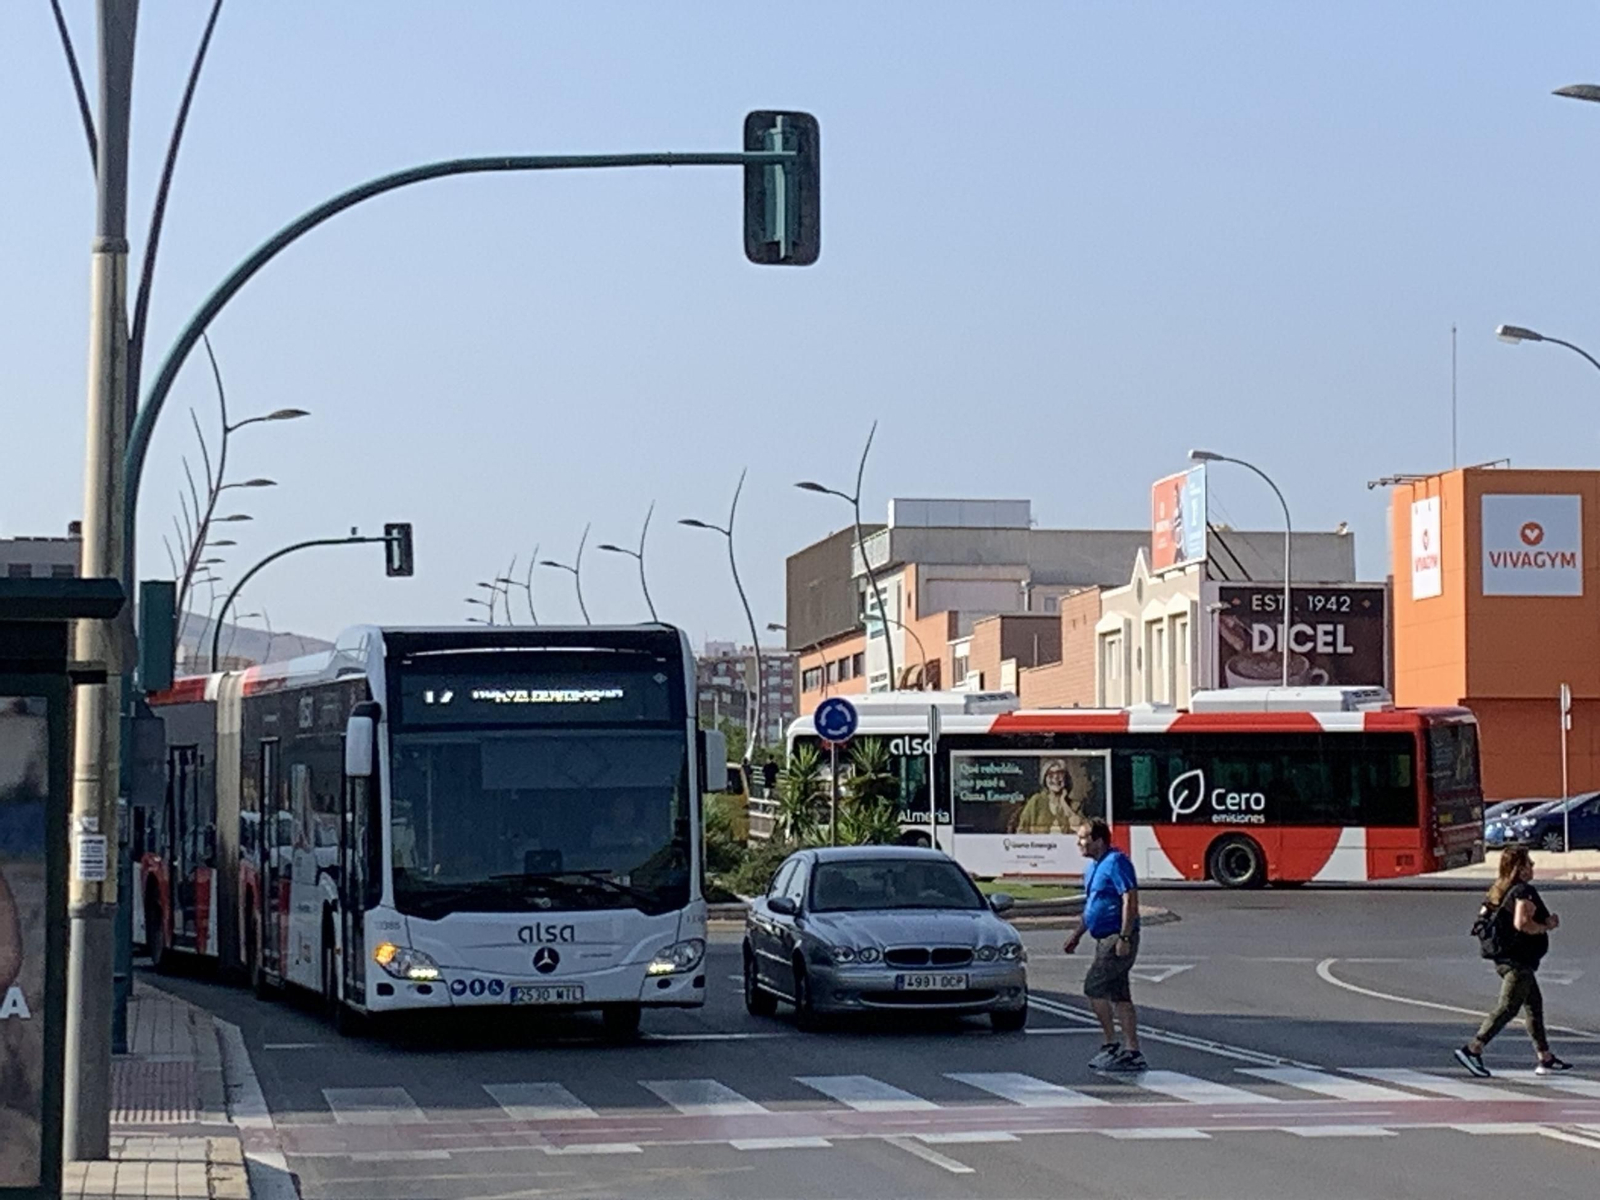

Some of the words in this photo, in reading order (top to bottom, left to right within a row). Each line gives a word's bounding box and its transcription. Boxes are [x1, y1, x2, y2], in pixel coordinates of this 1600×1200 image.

[1488, 551, 1577, 569] VIVAGYM
[1307, 595, 1351, 612] 1942
[1252, 623, 1354, 654] DICEL
[1211, 788, 1266, 810] Cero
[1211, 812, 1266, 824] emisiones
[517, 922, 576, 943] alsa
[0, 986, 31, 1019] A
